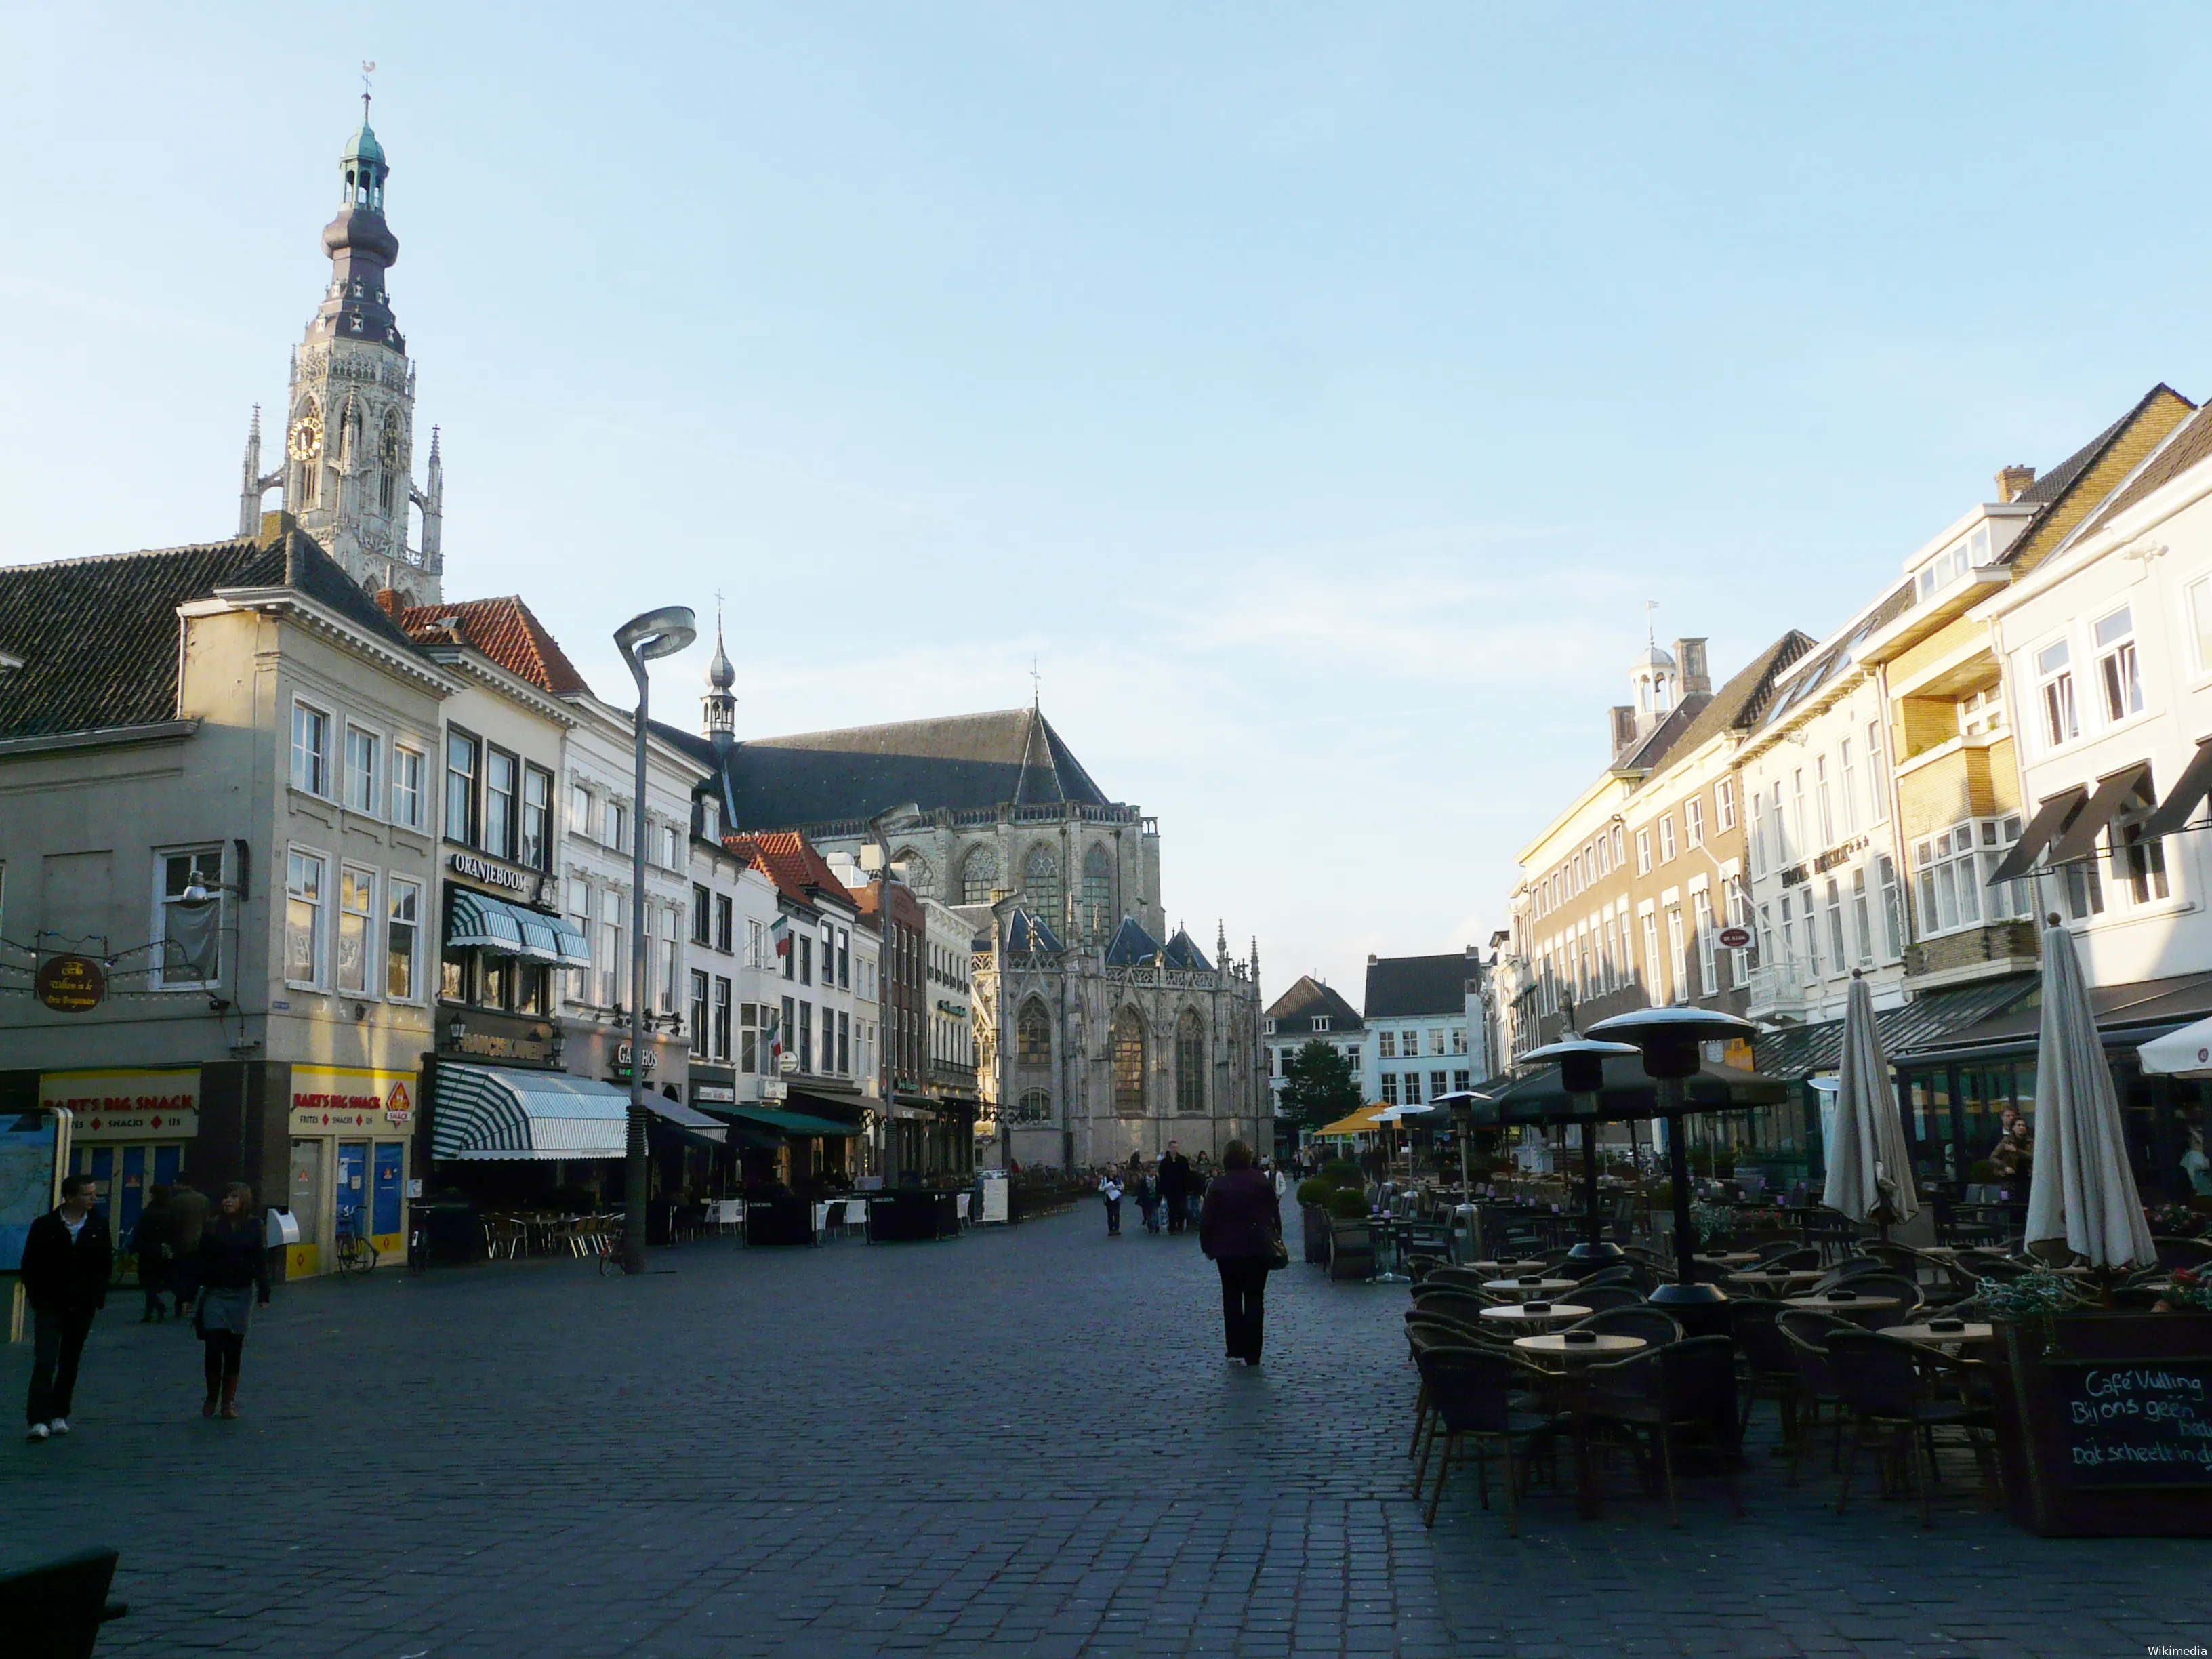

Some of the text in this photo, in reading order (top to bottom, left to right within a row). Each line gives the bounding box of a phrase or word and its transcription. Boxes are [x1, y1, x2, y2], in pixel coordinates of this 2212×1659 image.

[455, 854, 527, 892] ORANJEBOOM
[618, 1044, 658, 1067] GAHOS
[104, 1097, 131, 1111] BIG
[136, 1094, 193, 1111] SNACK
[294, 1093, 381, 1110] BART'S BIG SNACK
[108, 1118, 144, 1128] SNACKS
[300, 1115, 319, 1124] FRITES
[332, 1116, 353, 1124] SNACKS
[2085, 1370, 2133, 1397] Café
[2070, 1401, 2099, 1427] Bij
[2100, 1398, 2139, 1418] ons
